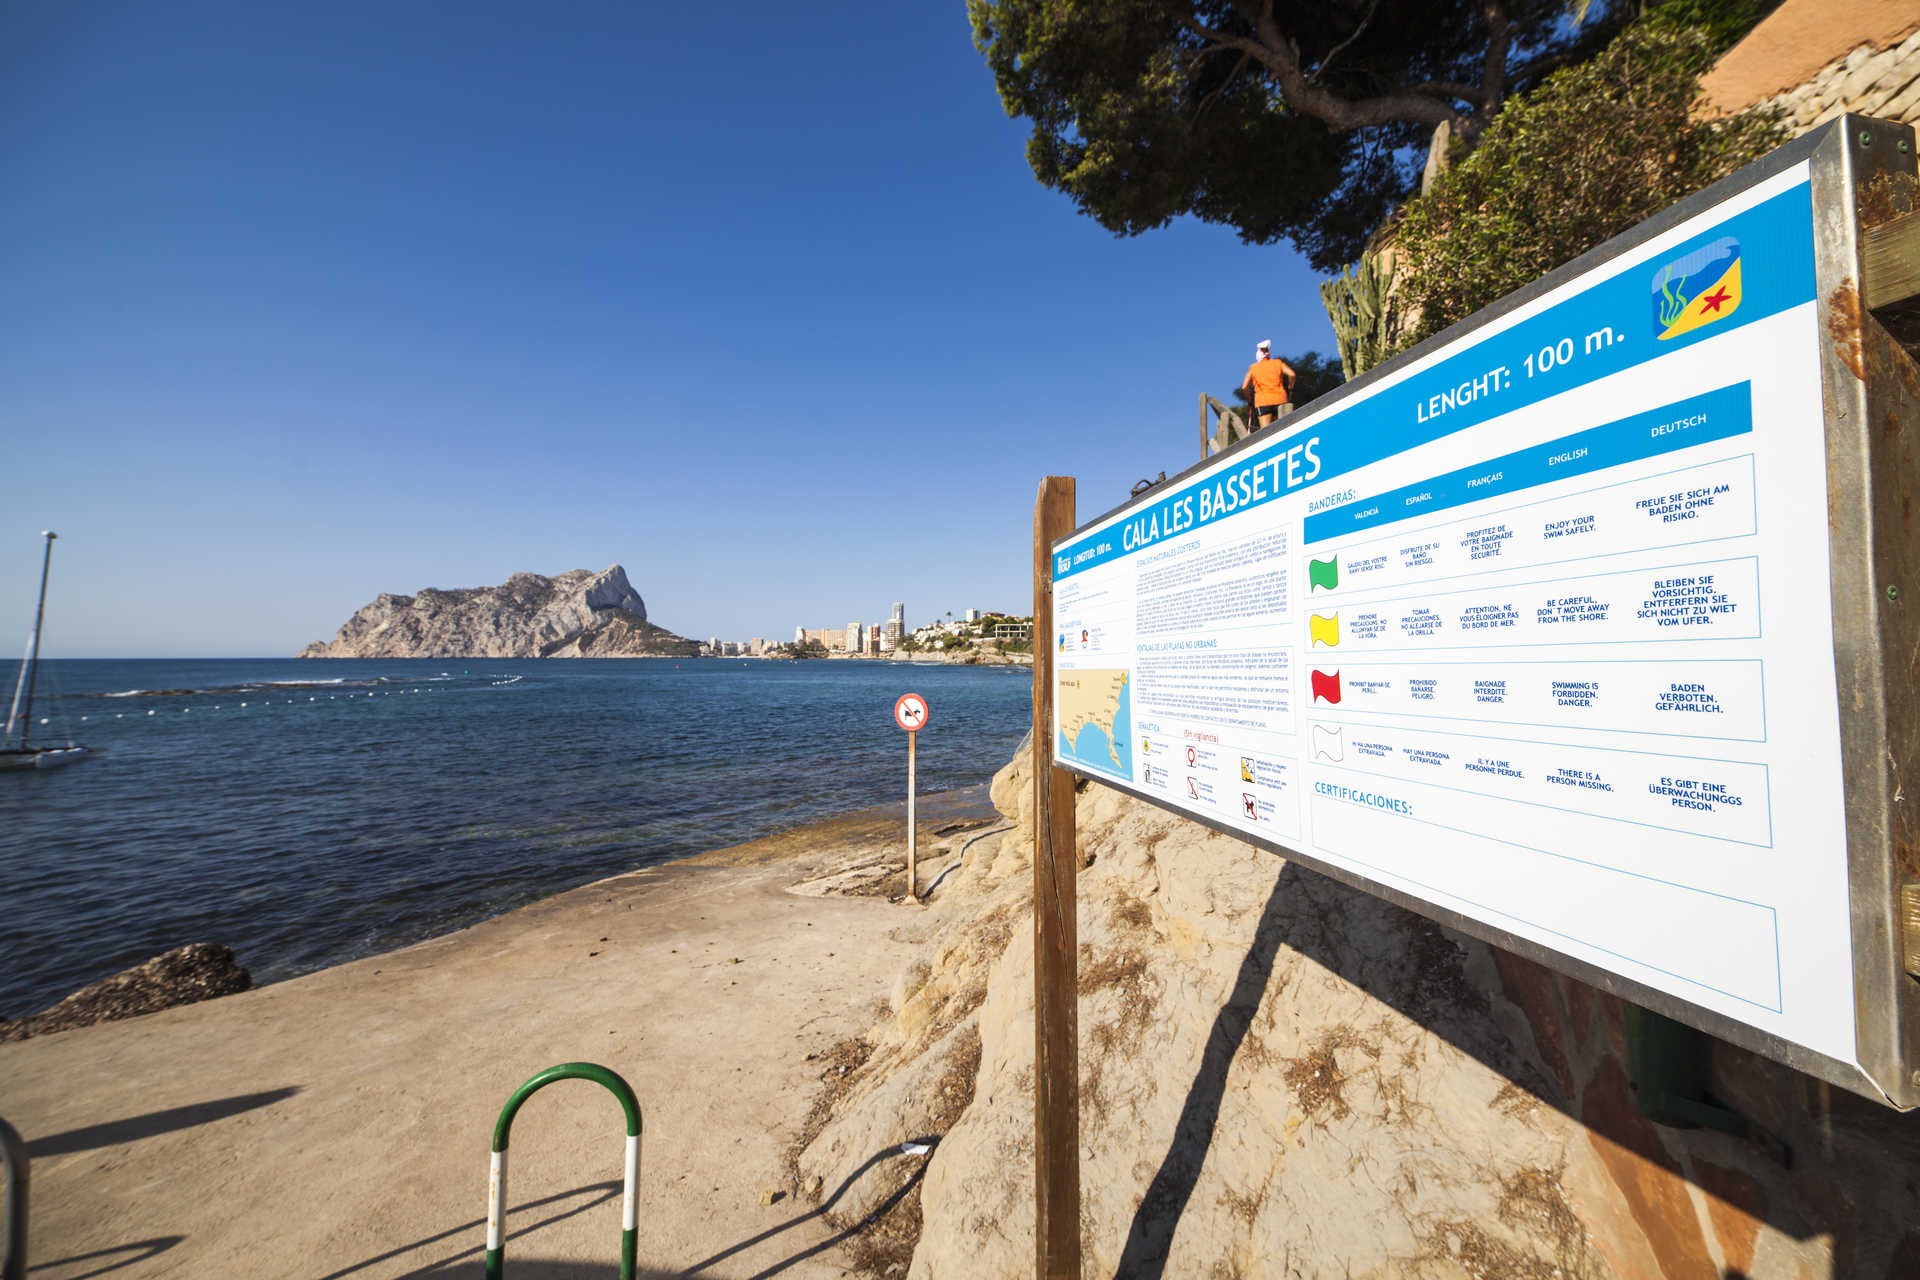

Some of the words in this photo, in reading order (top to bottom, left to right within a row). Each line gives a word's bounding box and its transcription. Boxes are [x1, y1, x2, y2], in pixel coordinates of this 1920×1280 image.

[1417, 366, 1511, 423] LENGHT:
[1523, 338, 1574, 378] 100
[1585, 326, 1625, 354] m.
[1651, 414, 1707, 438] DEUTSCH
[1548, 448, 1588, 466] ENGLISH
[1467, 472, 1503, 488] FRANÇAIS
[1123, 512, 1159, 551] CALA
[1164, 496, 1193, 536] LES
[1199, 436, 1321, 522] BASSETES
[1308, 488, 1356, 512] BANDERAS:
[1406, 492, 1432, 506] ESPAÑOL
[1636, 497, 1666, 509] FREUE
[1669, 493, 1684, 504] SIE
[1687, 488, 1711, 500] SICH
[1714, 484, 1730, 495] AM
[1649, 503, 1682, 516] BADEN
[1685, 497, 1714, 510] OHNE
[1545, 521, 1570, 531] ENJOY
[1572, 515, 1595, 527] YOUR
[1664, 511, 1699, 523] RISIKO.
[1460, 538, 1480, 547] VOTRE
[1482, 531, 1513, 543] BAIGNADE
[1467, 526, 1496, 538] PROFITEZ
[1544, 529, 1564, 540] SWIM
[1566, 524, 1596, 537] SAFELY.
[1400, 546, 1422, 556] DISFRUTE
[1481, 541, 1502, 550] TOUTE
[1654, 578, 1695, 589] BLEIBEN
[1698, 575, 1714, 585] SIE
[1652, 585, 1717, 598] VORSICHTIG.
[1564, 605, 1585, 614] MOVE
[1587, 603, 1610, 612] AWAY
[1644, 596, 1710, 609] ENTFERFERN
[1712, 595, 1728, 604] SIE
[1538, 615, 1559, 624] FROM
[1561, 614, 1576, 622] THE
[1578, 612, 1609, 621] SHORE.
[1637, 609, 1658, 618] SICH
[1660, 607, 1690, 617] NICHT
[1692, 606, 1707, 615] ZU
[1709, 604, 1737, 614] WIET
[1658, 618, 1680, 626] VOM
[1682, 616, 1713, 626] UFER.
[1552, 681, 1590, 690] SWIMMING
[1591, 682, 1599, 690] IS
[1670, 684, 1705, 692] BADEN
[1552, 690, 1599, 699] FORBIDDEN.
[1660, 693, 1718, 703] VERBOTEN.
[1558, 699, 1593, 707] DANGER.
[1655, 700, 1724, 713] GEFÄHRLICH.
[1465, 764, 1496, 774] PERSONNE
[1498, 769, 1525, 778] PERDUE.
[1557, 768, 1583, 778] THERE
[1586, 772, 1593, 780] IS
[1595, 773, 1600, 781] A
[1546, 775, 1576, 787] PERSON
[1578, 780, 1614, 792] MISSING.
[1661, 777, 1672, 786] ES
[1676, 779, 1699, 790] GIBT
[1702, 782, 1726, 793] EINE
[1314, 781, 1413, 816] CERTIFICACIONES:
[1649, 783, 1742, 806] ÜBERWACHUNGGS
[1672, 798, 1716, 813] PERSON.
